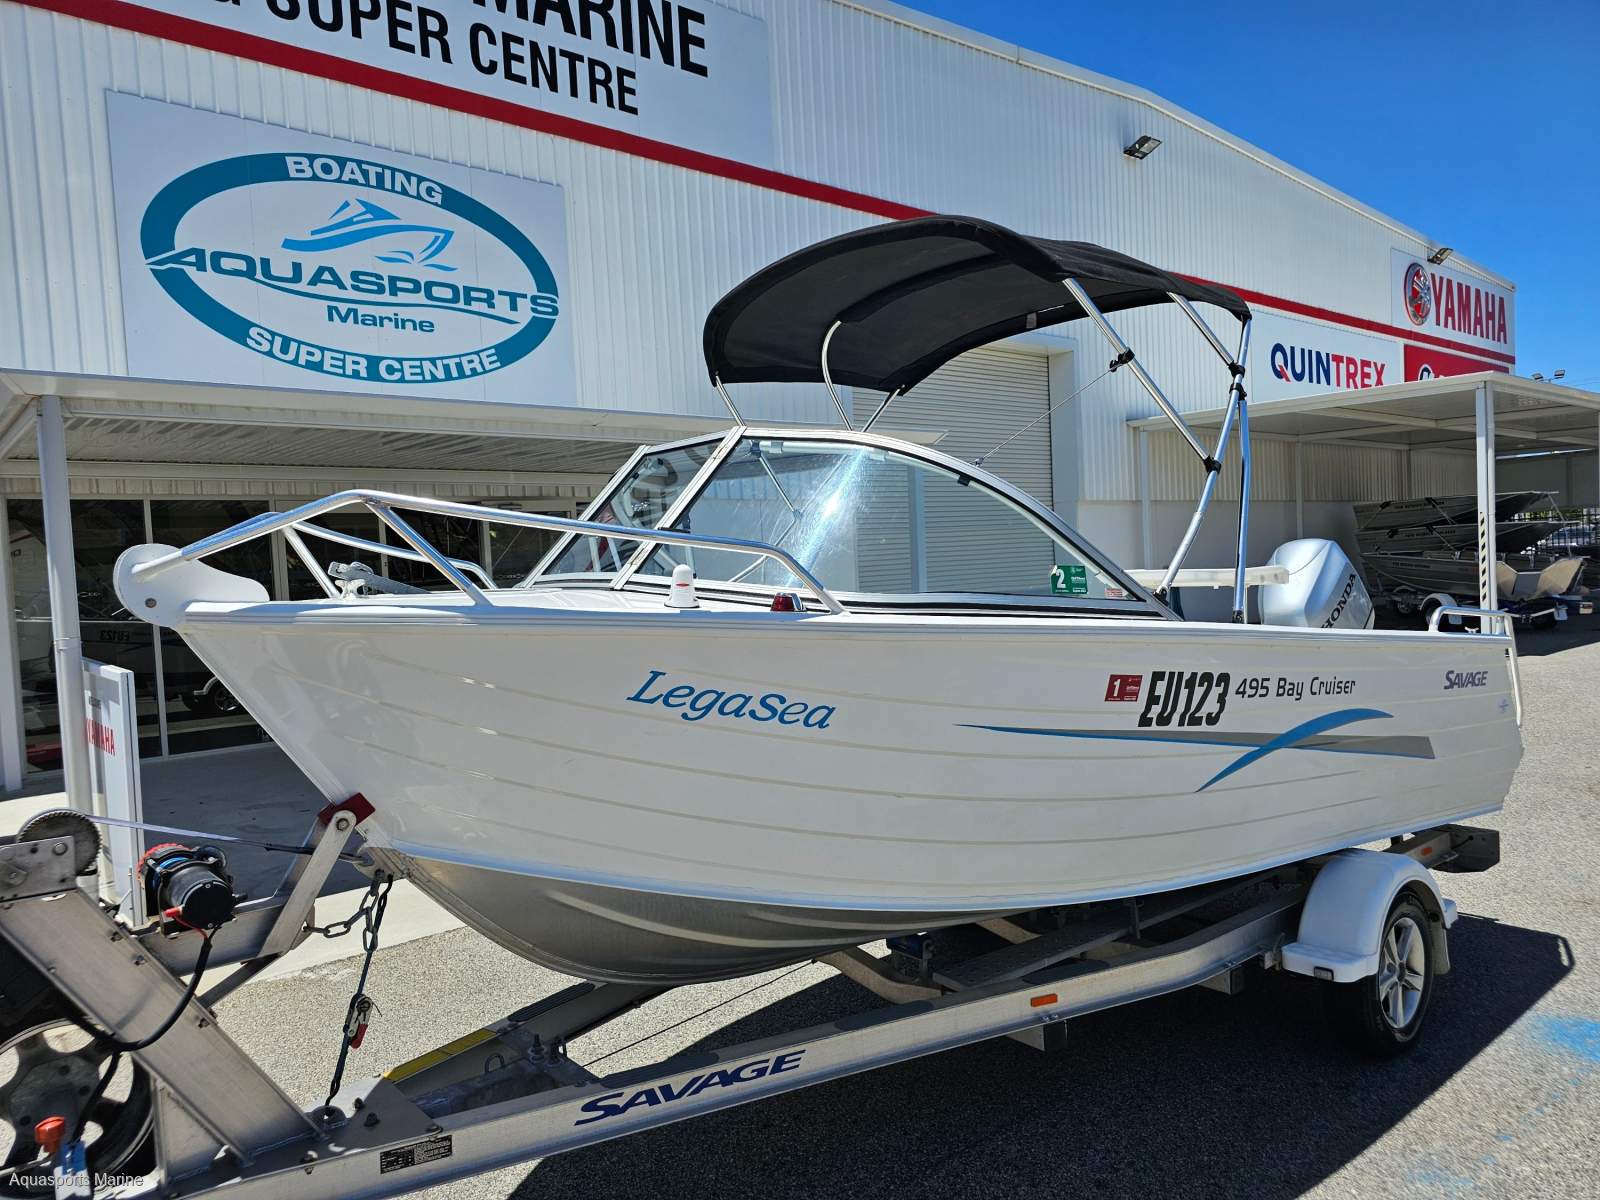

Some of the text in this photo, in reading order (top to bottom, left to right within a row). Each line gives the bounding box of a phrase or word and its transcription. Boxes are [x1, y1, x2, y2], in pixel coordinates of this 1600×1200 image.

[473, 0, 709, 78] RINE
[469, 22, 639, 116] CENTRE
[285, 155, 444, 206] BOATING
[145, 246, 560, 319] AQUASPORTS
[1430, 272, 1508, 345] YAMAHA
[326, 304, 436, 334] Marine
[246, 326, 502, 383] SUPER CENTRE
[1270, 342, 1386, 390] QUINTREX
[1055, 568, 1067, 589] 2
[1320, 573, 1356, 629] HONDA
[626, 670, 836, 729] LegaSea
[1113, 679, 1121, 697] 1
[1137, 671, 1231, 728] EU123
[1235, 675, 1356, 701] 495 Bay Cruiser
[1443, 669, 1489, 690] SAVAGE
[574, 1049, 806, 1126] SAVAGE
